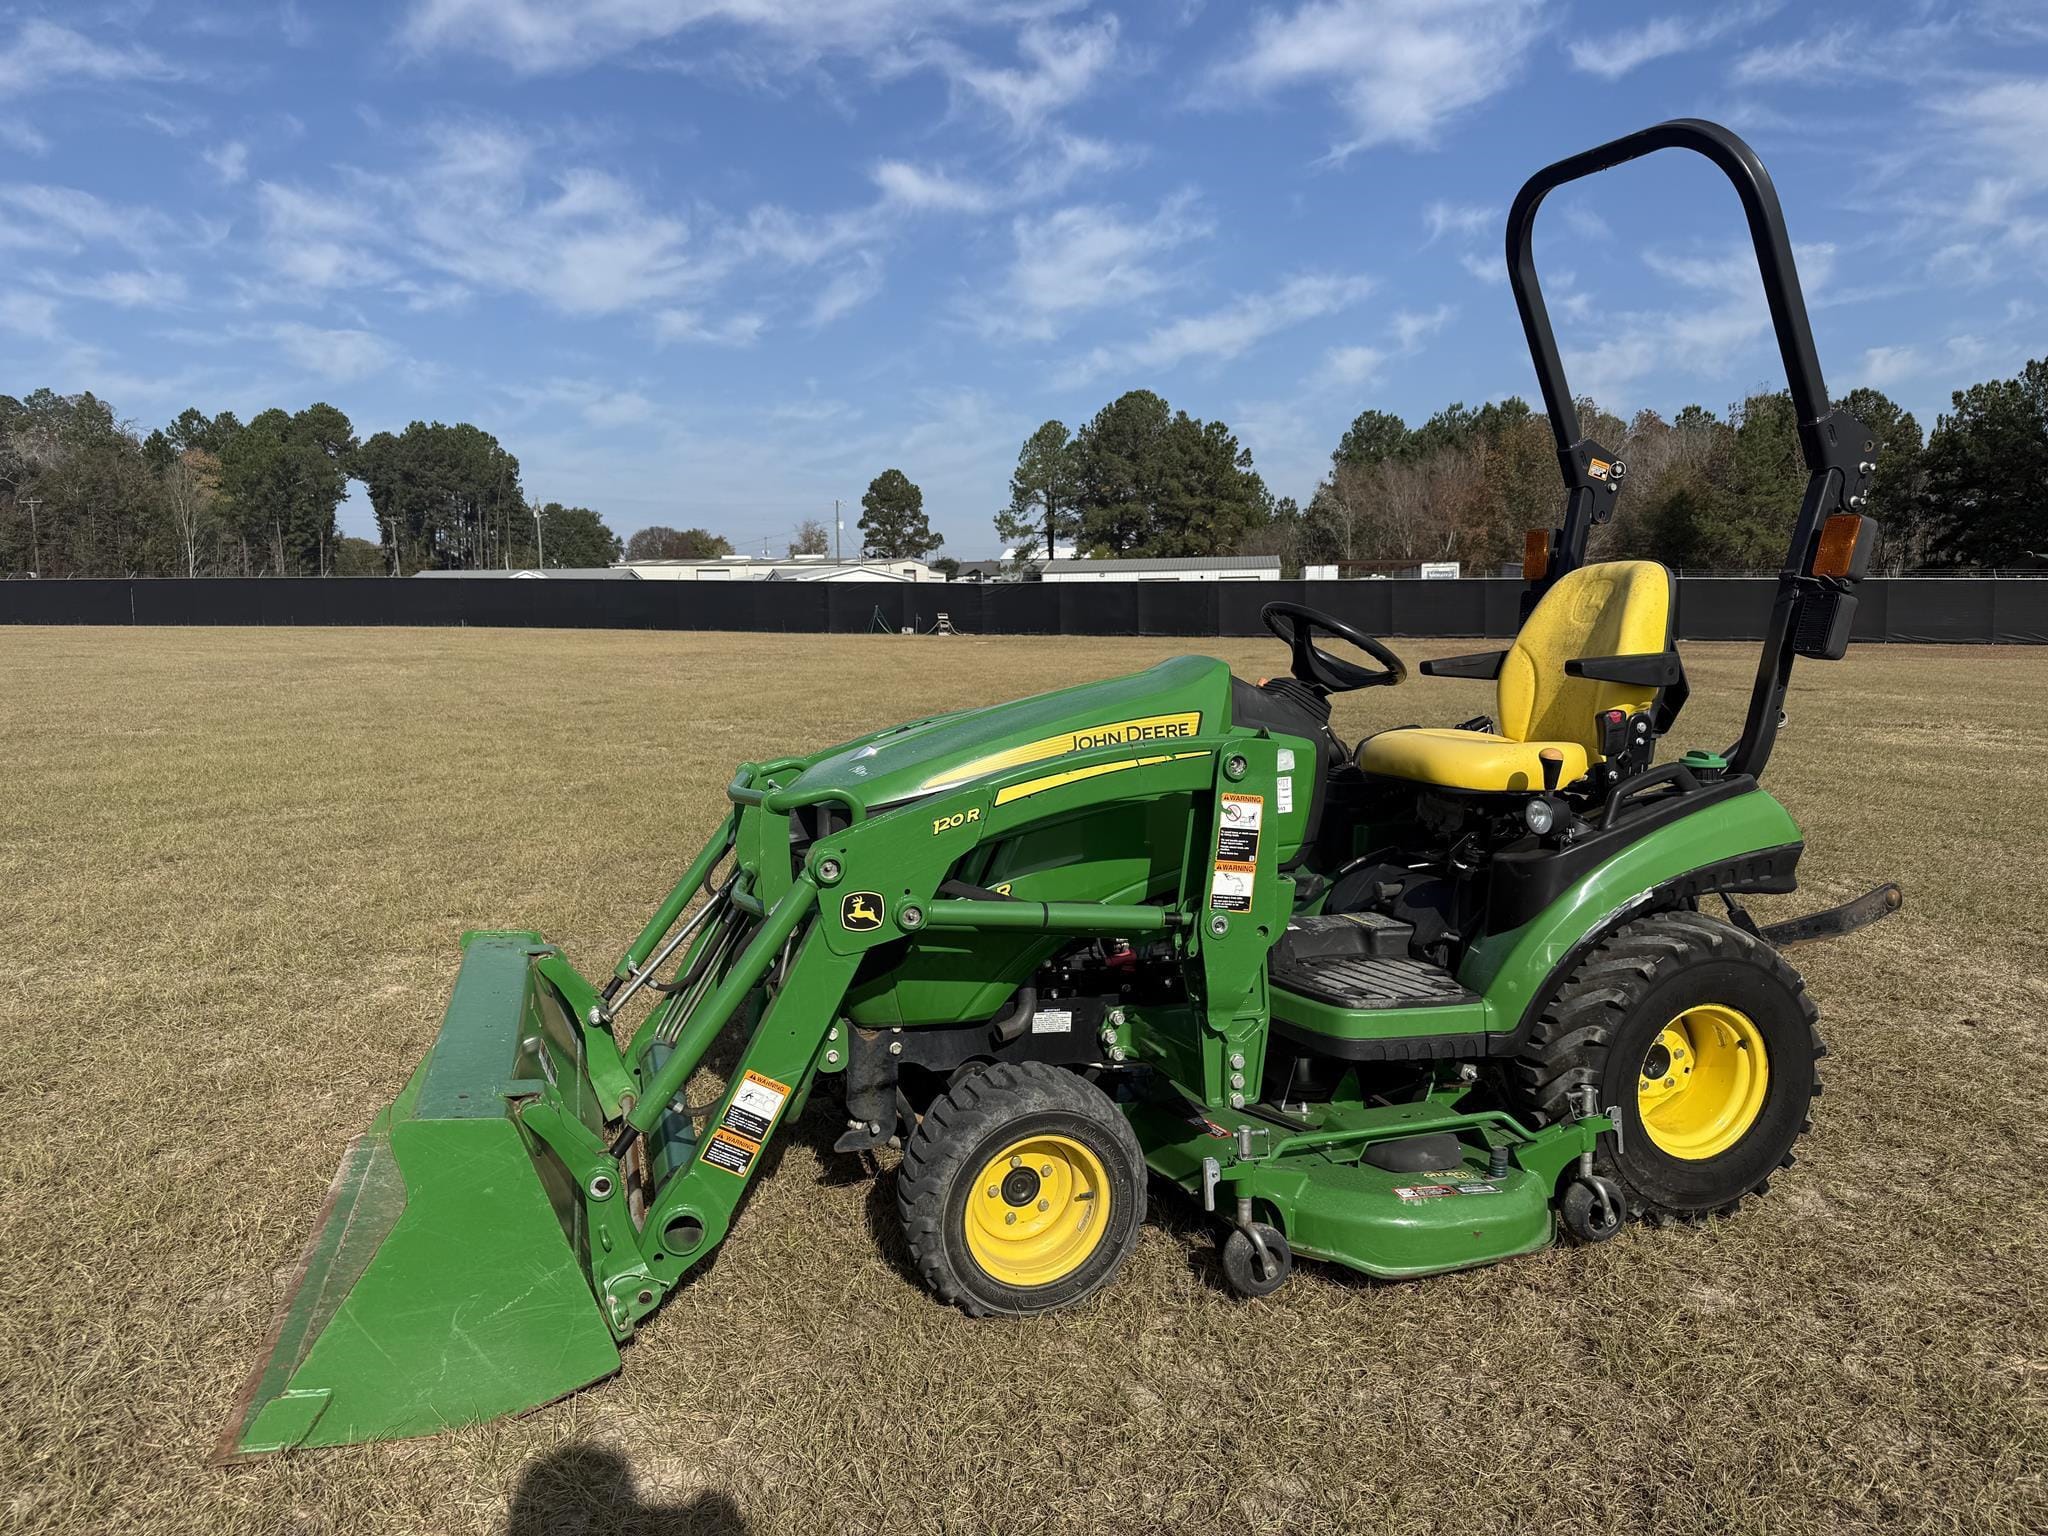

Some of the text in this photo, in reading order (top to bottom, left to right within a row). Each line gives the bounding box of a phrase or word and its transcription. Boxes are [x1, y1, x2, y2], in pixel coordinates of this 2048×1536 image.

[1067, 723, 1190, 752] JOHN DEERE
[1229, 794, 1262, 804] WARNING
[1222, 863, 1255, 873] WARNING
[756, 1076, 784, 1091] WARNING
[726, 1136, 754, 1151] WARNING
